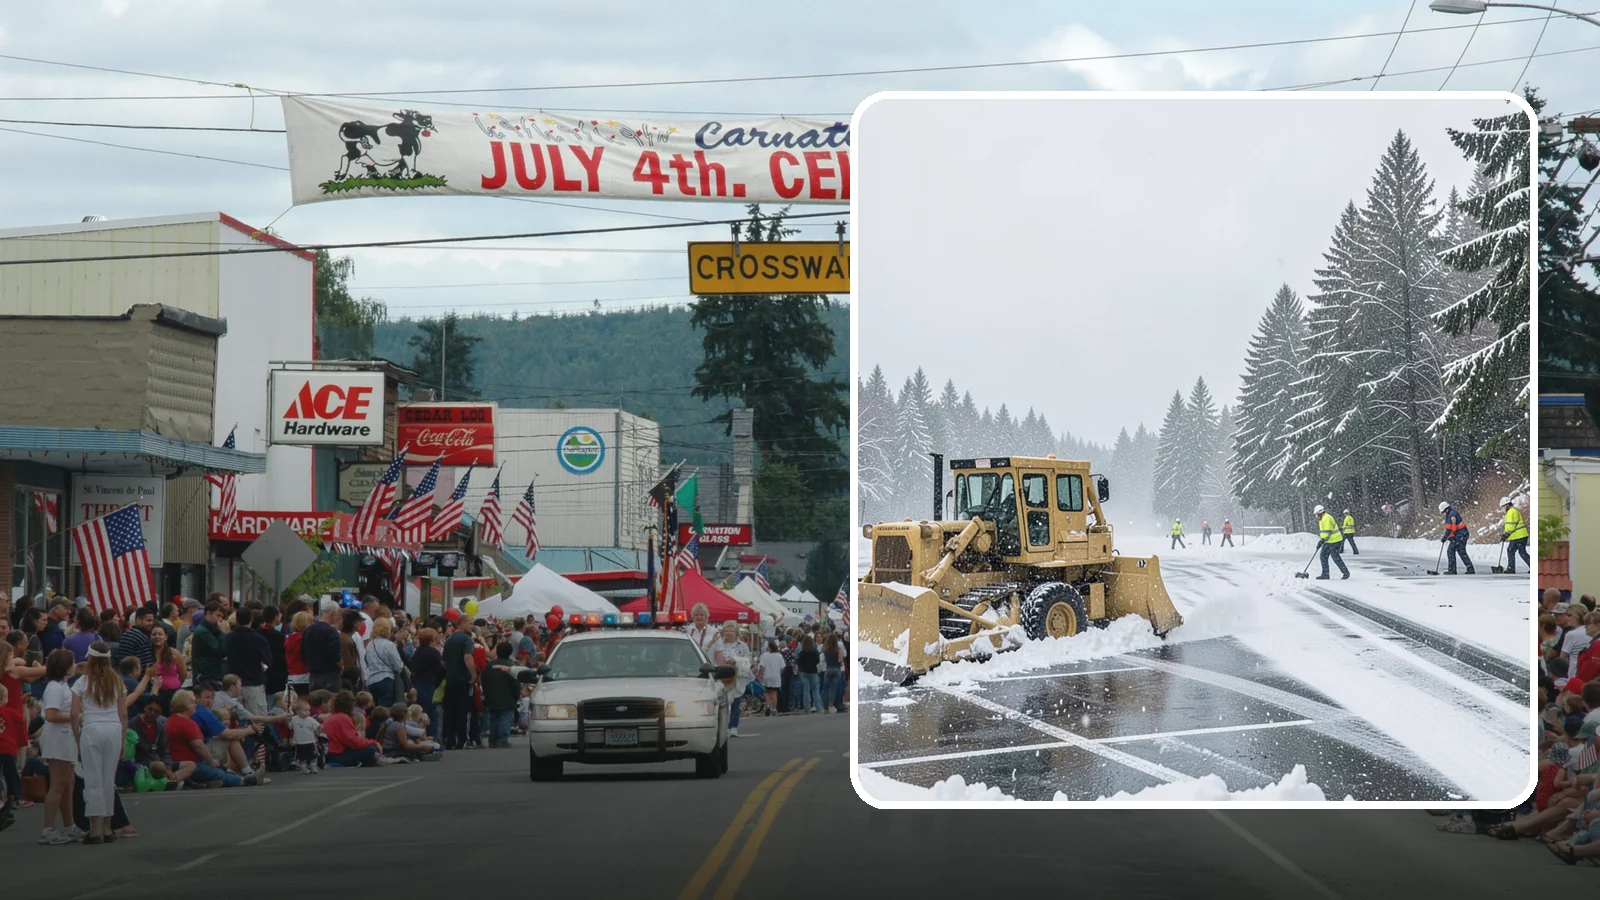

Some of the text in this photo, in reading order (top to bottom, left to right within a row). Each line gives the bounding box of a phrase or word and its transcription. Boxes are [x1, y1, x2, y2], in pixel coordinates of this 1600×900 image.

[695, 121, 850, 149] Carnat
[481, 141, 604, 192] JULY
[633, 149, 746, 198] 4th.
[697, 254, 850, 280] CROSSWA
[283, 380, 373, 420] ACE
[405, 409, 452, 421] CEDAR
[283, 421, 370, 436] Hardware
[416, 428, 477, 447] Coca-Cola
[96, 485, 124, 495] Vincent
[126, 486, 135, 494] de
[138, 486, 155, 495] Paul
[213, 516, 330, 535] HARDARE
[699, 535, 730, 543] GLASS
